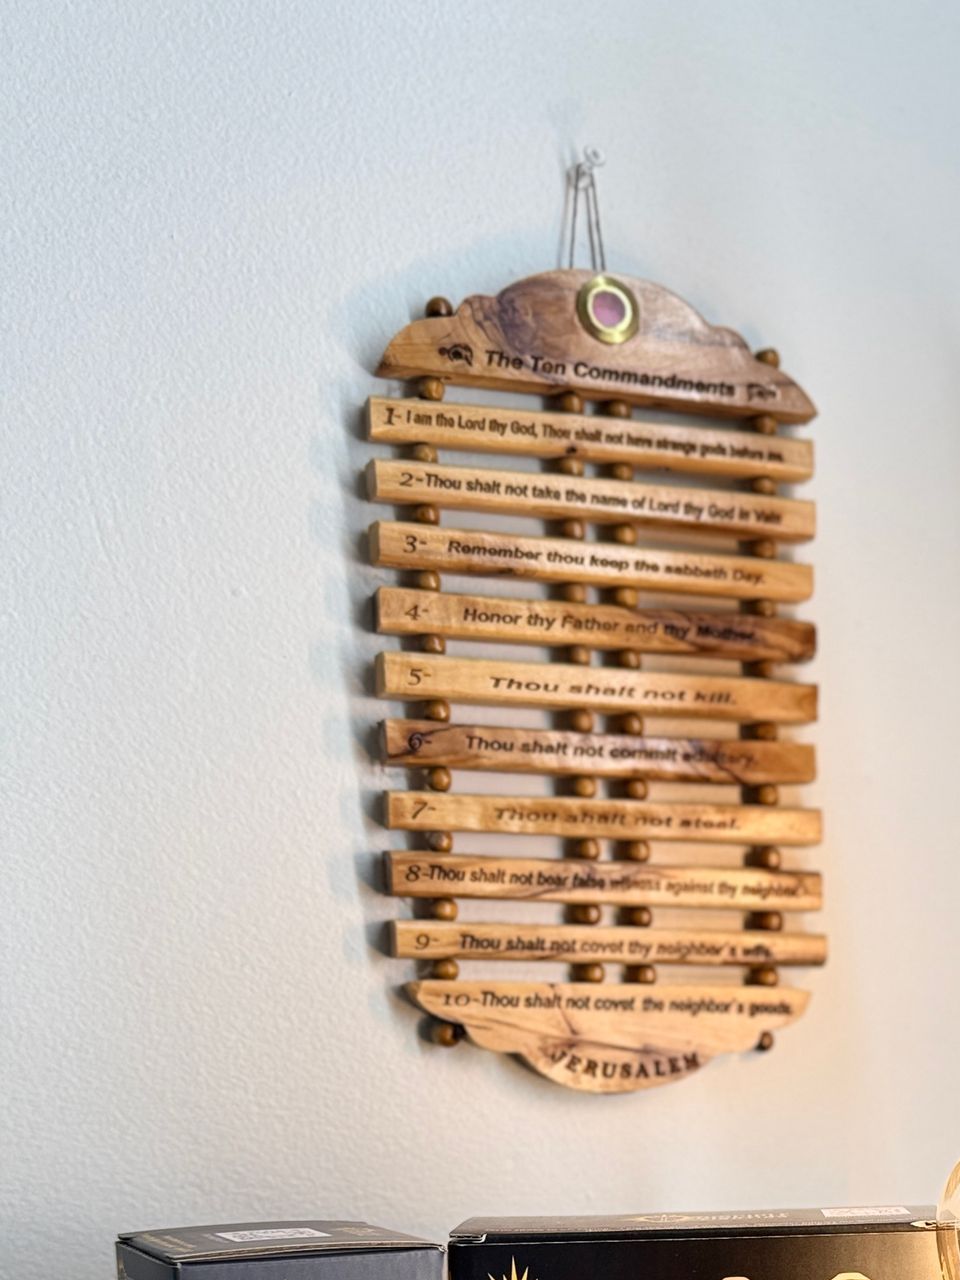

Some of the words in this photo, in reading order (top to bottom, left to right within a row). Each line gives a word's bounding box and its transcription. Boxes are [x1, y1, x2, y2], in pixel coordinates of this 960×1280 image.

[484, 349, 524, 370] The
[531, 355, 566, 375] Ten
[573, 361, 736, 397] Commandments
[414, 414, 433, 426] am
[435, 412, 455, 428] the
[458, 415, 486, 432] Lord
[488, 418, 508, 437] thy
[510, 420, 538, 439] God,
[542, 424, 571, 440] Thou
[574, 426, 603, 444] shalt
[605, 431, 625, 445] not
[465, 478, 501, 495] shalt
[504, 483, 529, 498] not
[531, 484, 562, 501] take
[565, 488, 587, 504] the
[591, 493, 628, 508] name
[631, 496, 647, 510] of
[650, 497, 680, 514] Lord
[683, 502, 704, 520] thy
[708, 503, 736, 520] God
[447, 539, 543, 561] Remember
[546, 550, 585, 566] thou
[589, 555, 630, 573] keep
[633, 560, 660, 573] the
[462, 607, 522, 627] Honor
[526, 613, 557, 631] thy
[561, 614, 619, 633] Father
[624, 621, 659, 635] and
[489, 675, 560, 694] Thou
[568, 682, 637, 700] shalt
[642, 688, 688, 702] not
[465, 735, 515, 752] Thou
[521, 740, 569, 757] shalt
[572, 745, 605, 759] not
[493, 806, 558, 823] Thou
[564, 811, 627, 826] shalt
[633, 815, 673, 829] not
[469, 869, 506, 886] shalt
[509, 872, 534, 886] not
[537, 871, 569, 888] bear
[717, 880, 738, 899] thy
[459, 933, 500, 950] Thou
[505, 936, 547, 952] shalt
[550, 939, 578, 954] not
[580, 940, 626, 955] covet
[628, 942, 652, 959] thy
[524, 993, 562, 1009] shalt
[565, 996, 592, 1010] not
[594, 997, 635, 1012] covet
[642, 997, 664, 1013] the
[550, 1049, 701, 1079] JERUSALEM
